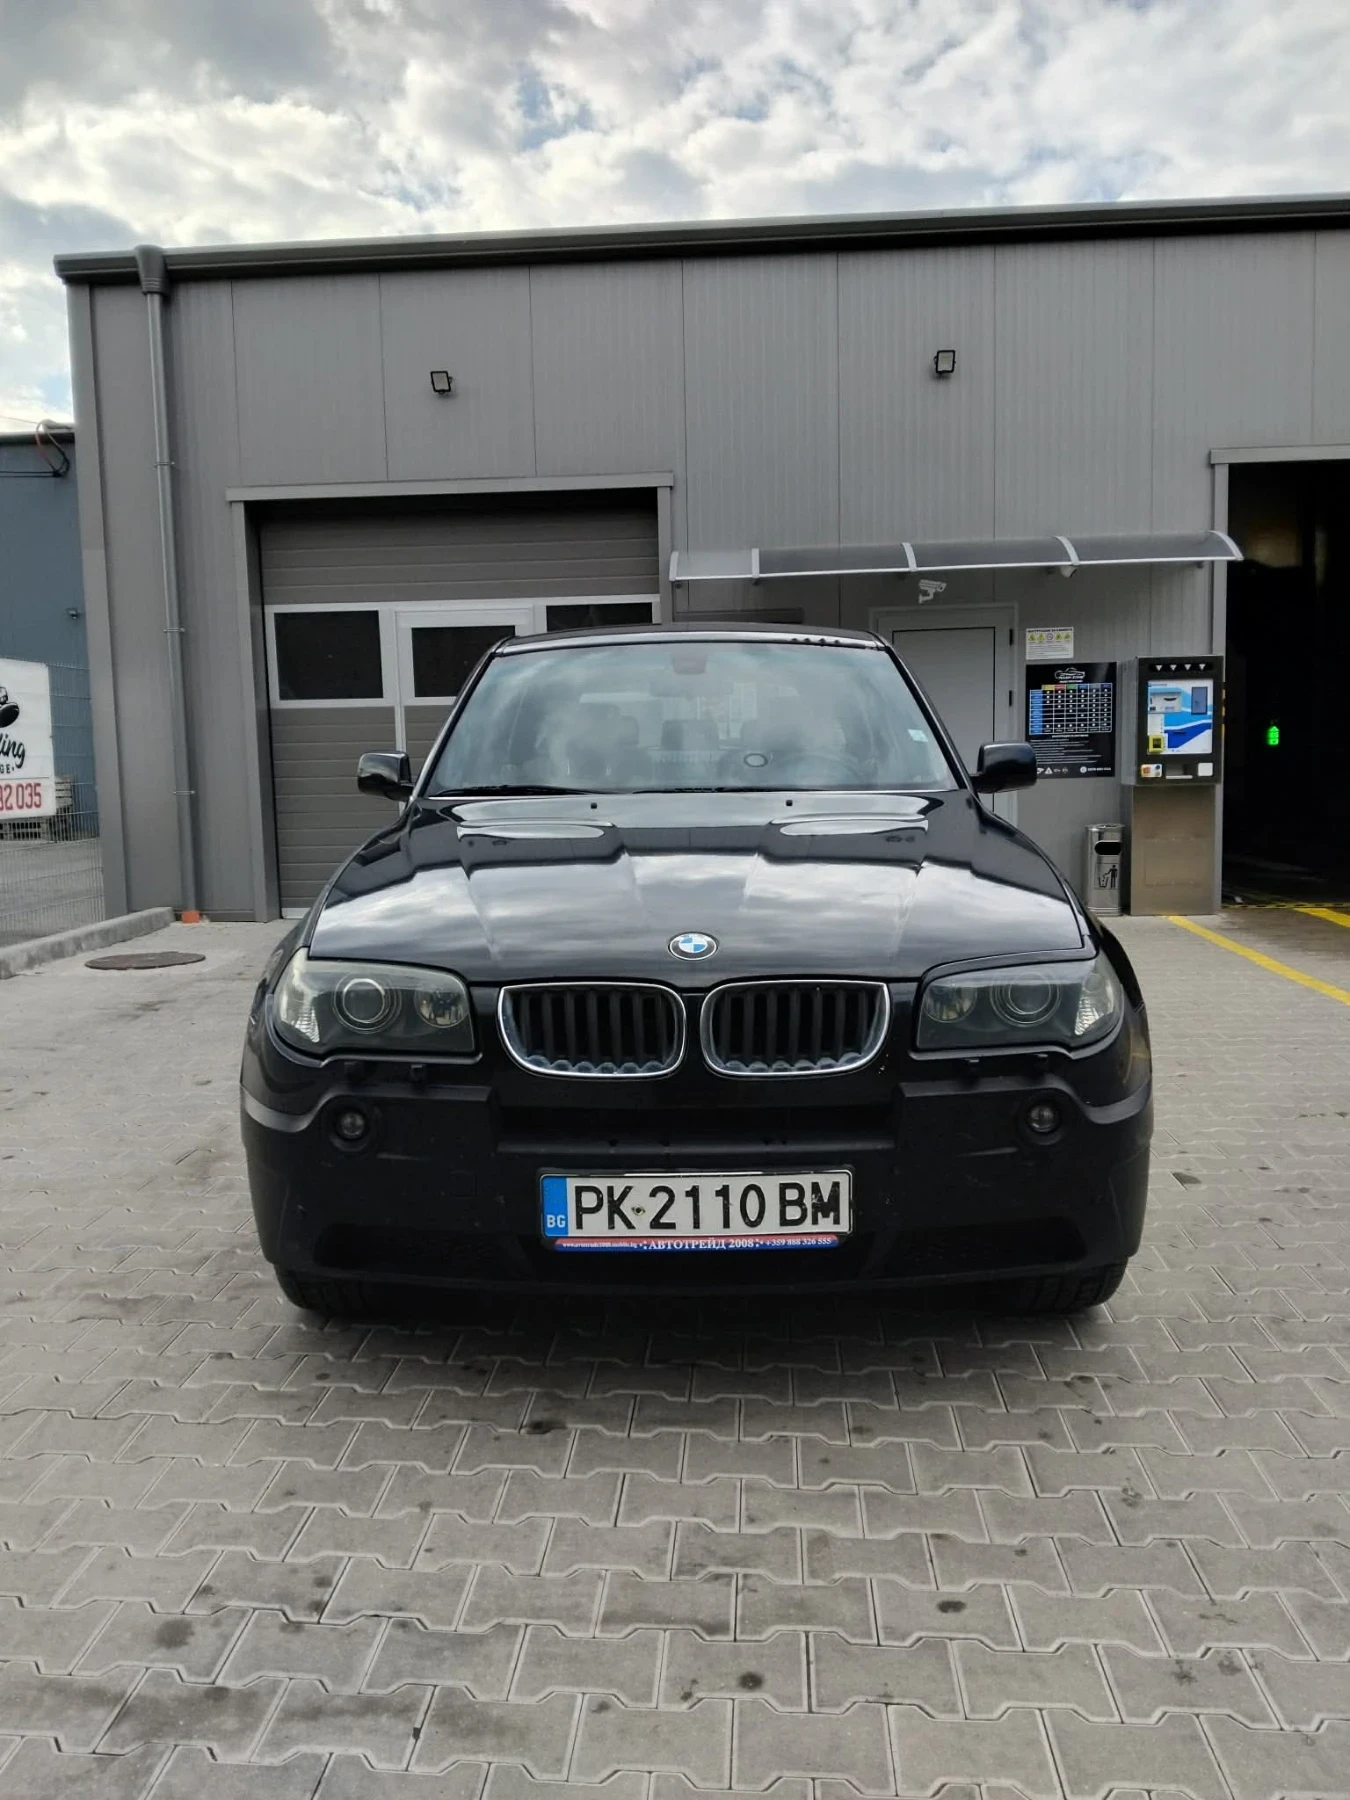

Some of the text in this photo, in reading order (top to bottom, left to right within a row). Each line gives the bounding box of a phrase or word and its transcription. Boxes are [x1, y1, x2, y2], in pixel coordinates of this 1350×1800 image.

[16, 782, 42, 810] 035
[574, 1180, 841, 1230] PK 2110 BM
[546, 1213, 566, 1228] BG
[648, 1237, 727, 1250] АВТОТРЕЙД
[729, 1238, 754, 1249] 2008
